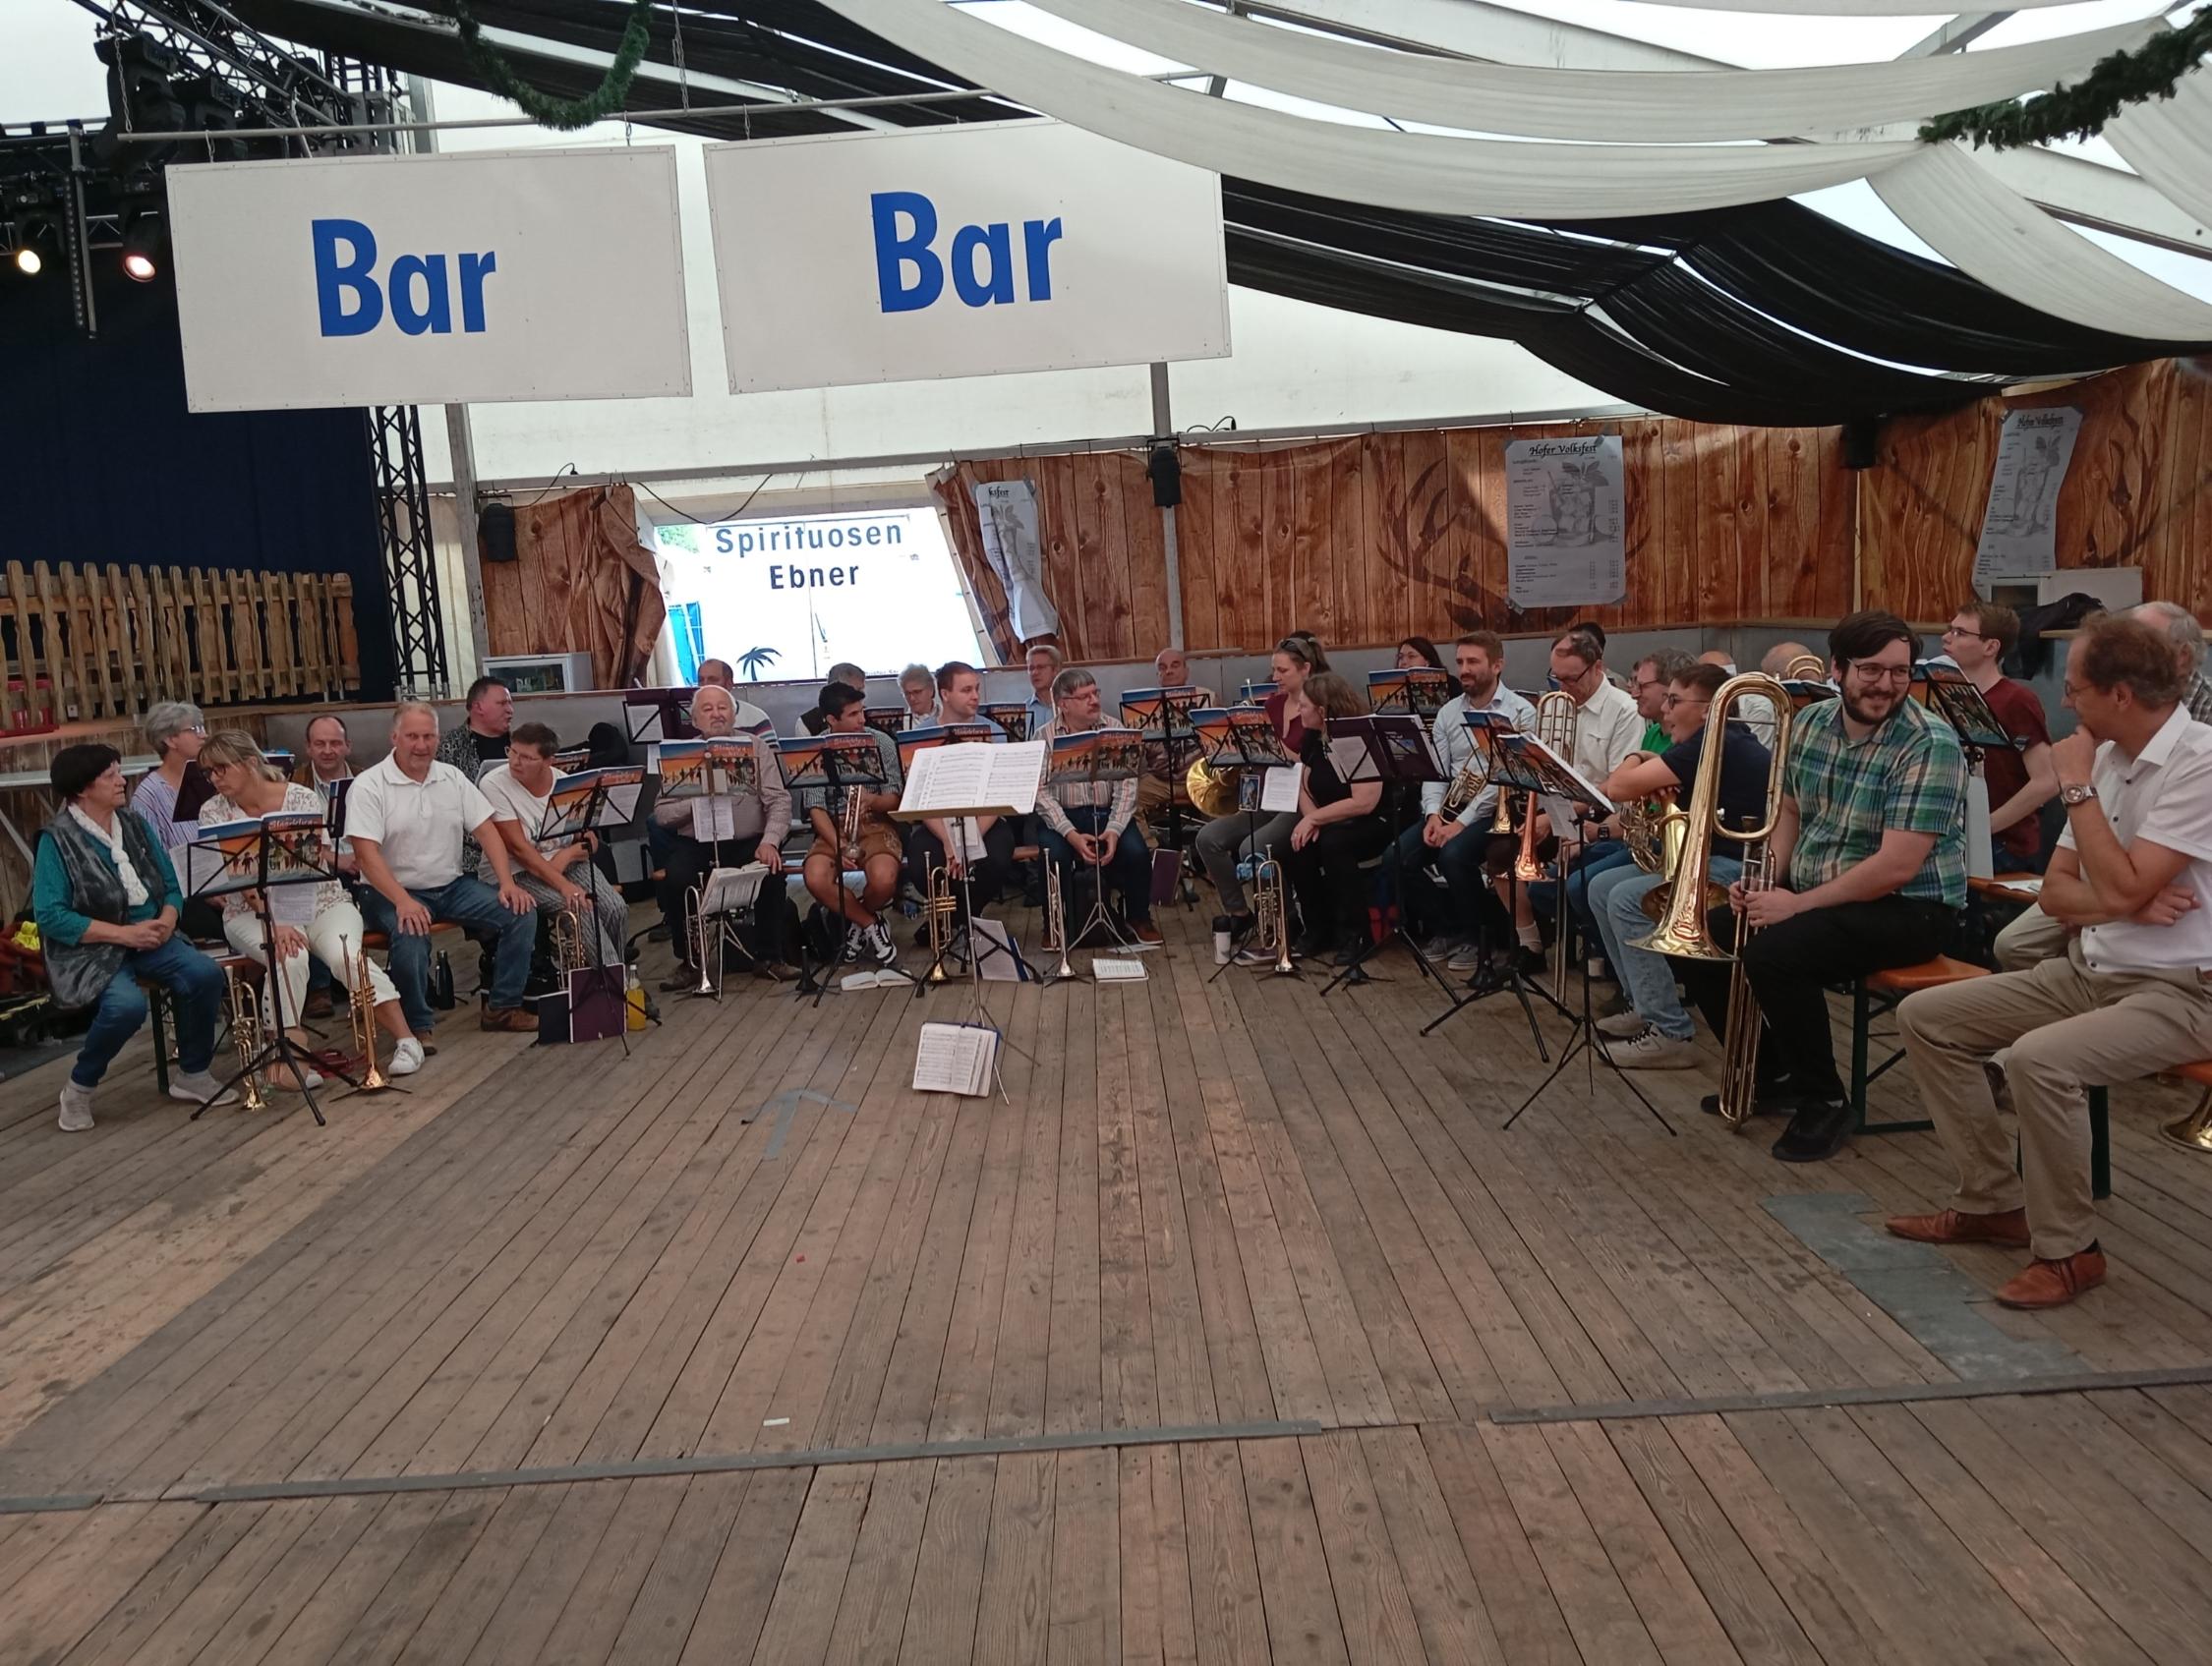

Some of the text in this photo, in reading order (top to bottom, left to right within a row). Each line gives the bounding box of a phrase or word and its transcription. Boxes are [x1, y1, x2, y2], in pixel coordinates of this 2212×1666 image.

[870, 191, 1062, 314] Bar
[312, 218, 495, 336] Bar
[1529, 441, 1598, 458] Hofer Volksfest
[716, 524, 902, 558] Spirituosen
[769, 564, 860, 590] Ebner
